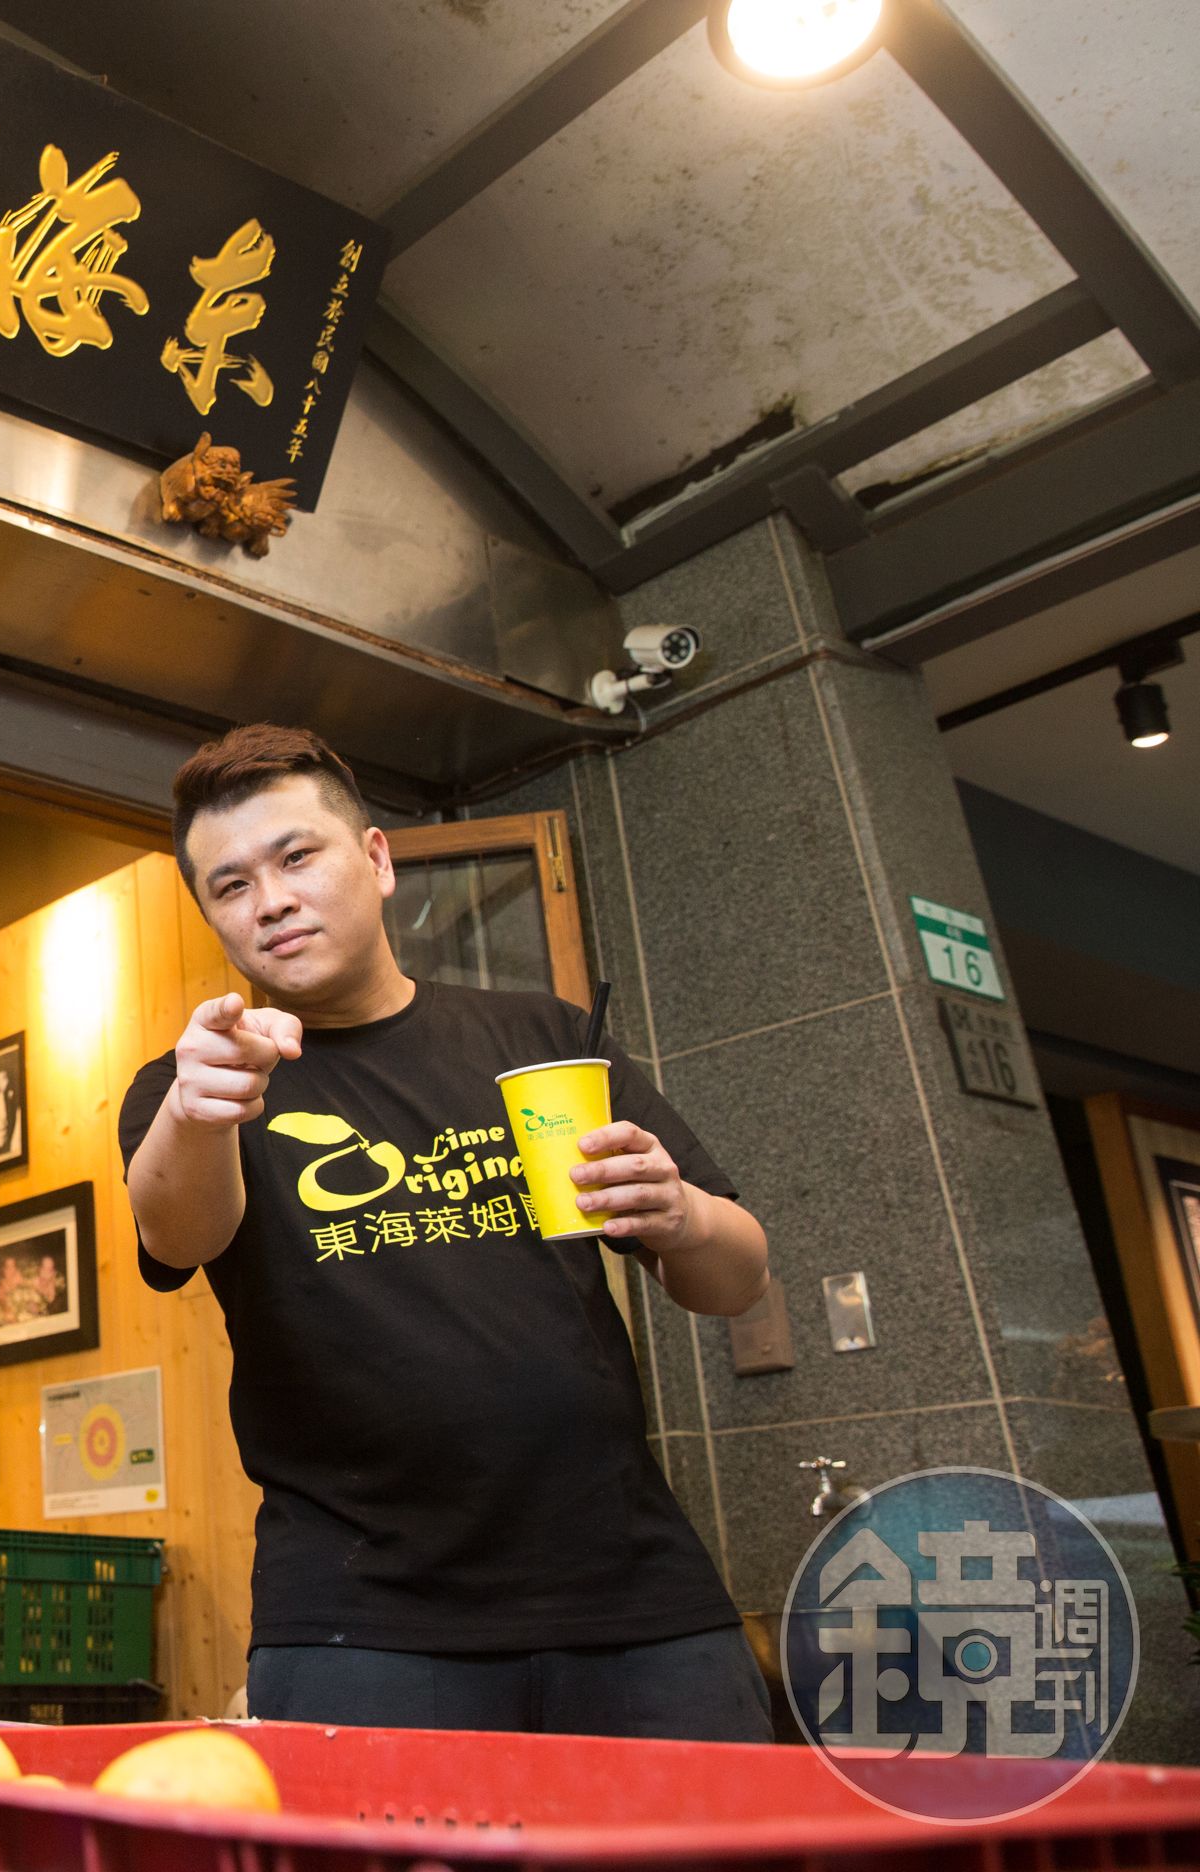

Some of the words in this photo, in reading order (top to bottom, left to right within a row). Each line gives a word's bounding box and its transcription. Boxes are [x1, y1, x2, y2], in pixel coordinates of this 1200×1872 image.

[286, 239, 363, 463] 創立於民國八十五年
[941, 944, 983, 987] 16
[412, 1126, 505, 1165] Lime
[298, 1138, 525, 1212] Origina
